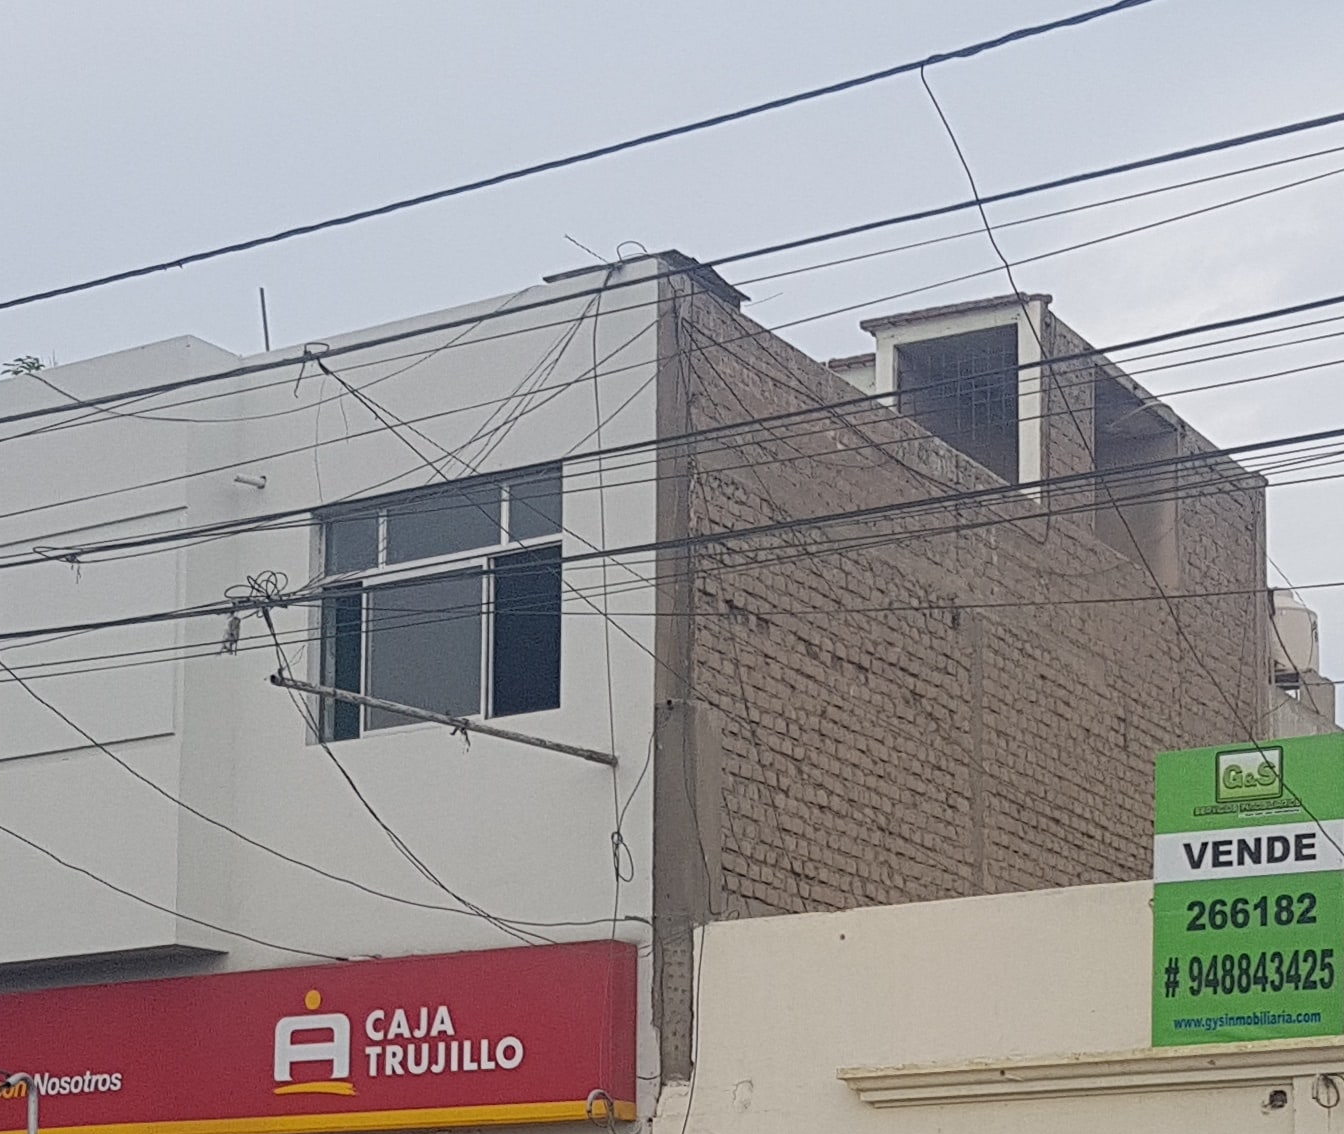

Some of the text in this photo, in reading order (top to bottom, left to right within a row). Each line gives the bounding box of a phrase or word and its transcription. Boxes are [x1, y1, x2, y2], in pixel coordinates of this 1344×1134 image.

[1222, 761, 1277, 790] G&S
[1183, 833, 1317, 870] VENDE
[1186, 892, 1318, 932] 266182
[1164, 948, 1335, 998] # 948843425
[365, 1004, 455, 1042] CAJA
[1174, 1010, 1321, 1031] www.gysinmobiliaria.com
[365, 1035, 525, 1078] TRUJILLO
[33, 1070, 122, 1096] Nosotros
